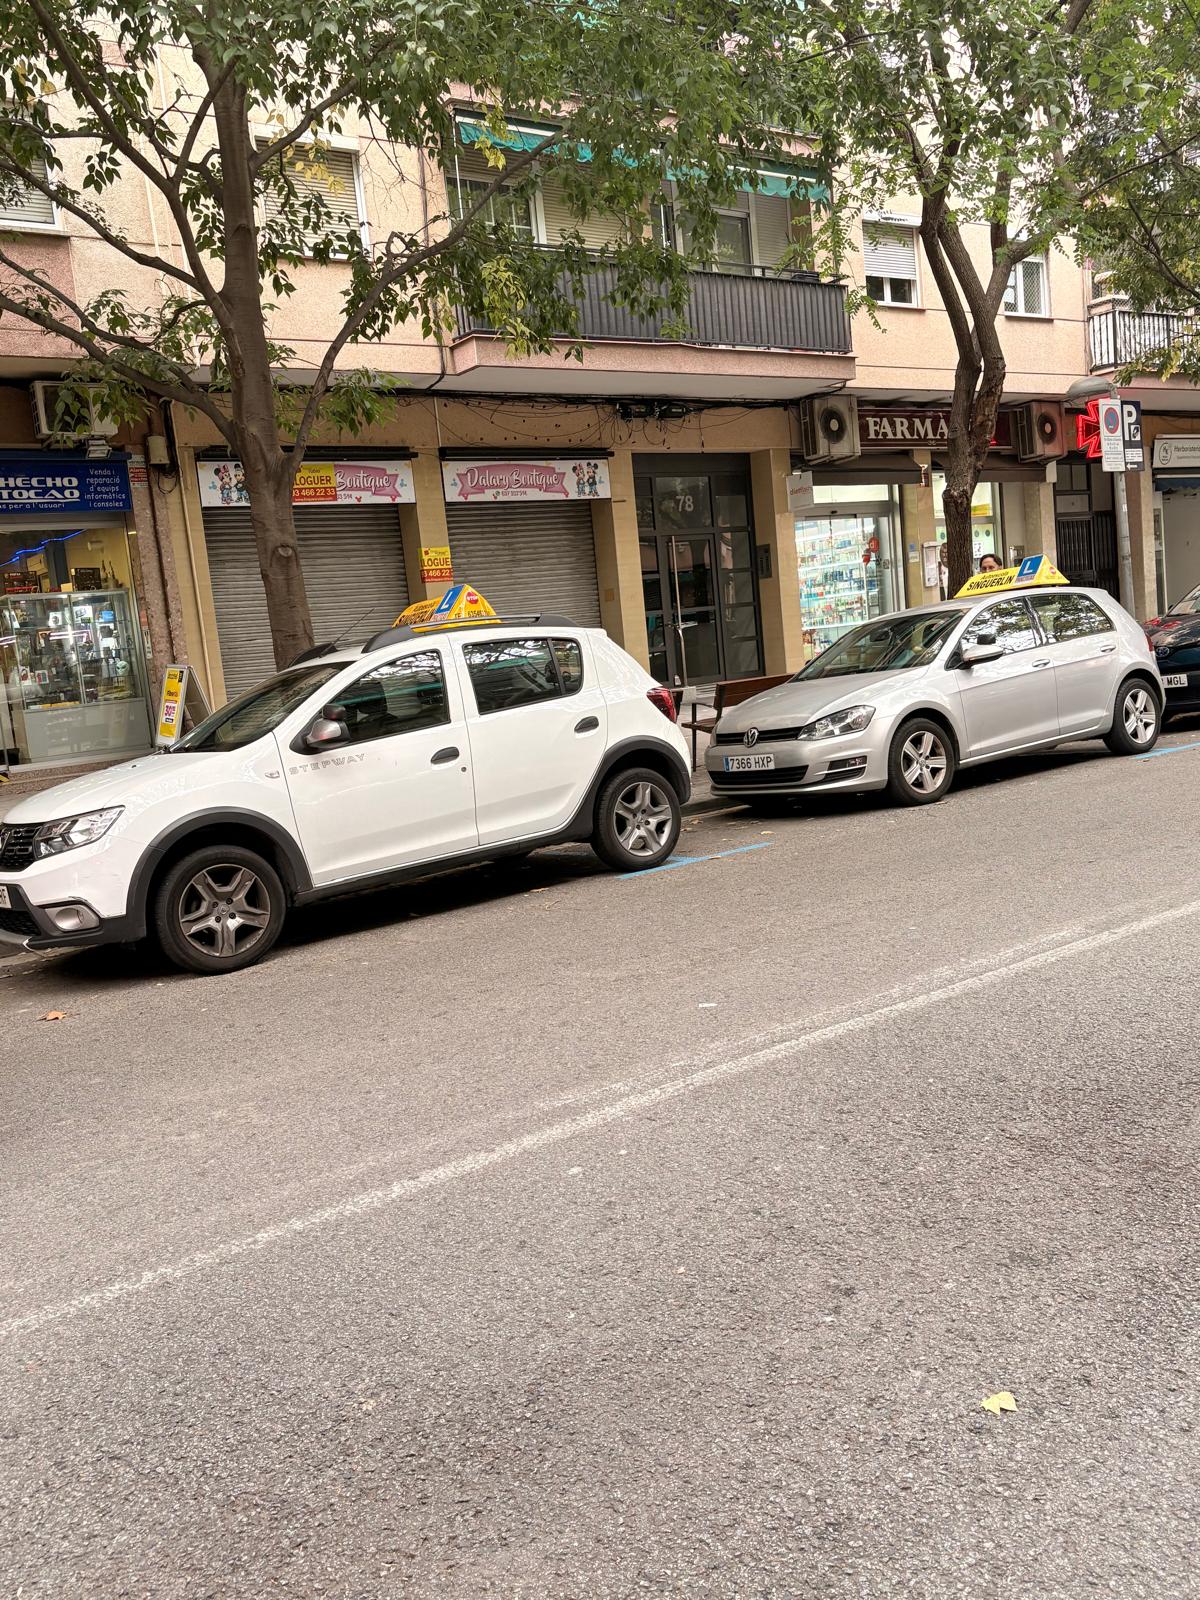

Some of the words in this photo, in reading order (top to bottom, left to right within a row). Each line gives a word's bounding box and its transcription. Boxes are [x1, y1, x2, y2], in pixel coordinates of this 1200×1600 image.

[866, 413, 948, 439] FARMÀ
[1123, 404, 1137, 441] P
[0, 477, 79, 487] HECHO
[86, 476, 120, 484] reparació
[293, 475, 332, 485] LOGUER
[335, 469, 391, 495] Boutique
[511, 468, 560, 490] Boutique
[315, 488, 326, 496] 22
[326, 488, 336, 496] 33
[676, 495, 694, 512] 78
[421, 557, 451, 568] LOGUE
[1023, 560, 1034, 574] L
[967, 575, 1015, 591] SINGUERLIN
[441, 591, 453, 610] L
[1166, 676, 1186, 686] MGL
[289, 753, 365, 775] STEPWAY
[729, 757, 752, 770] 7366
[754, 756, 772, 769] HXP
